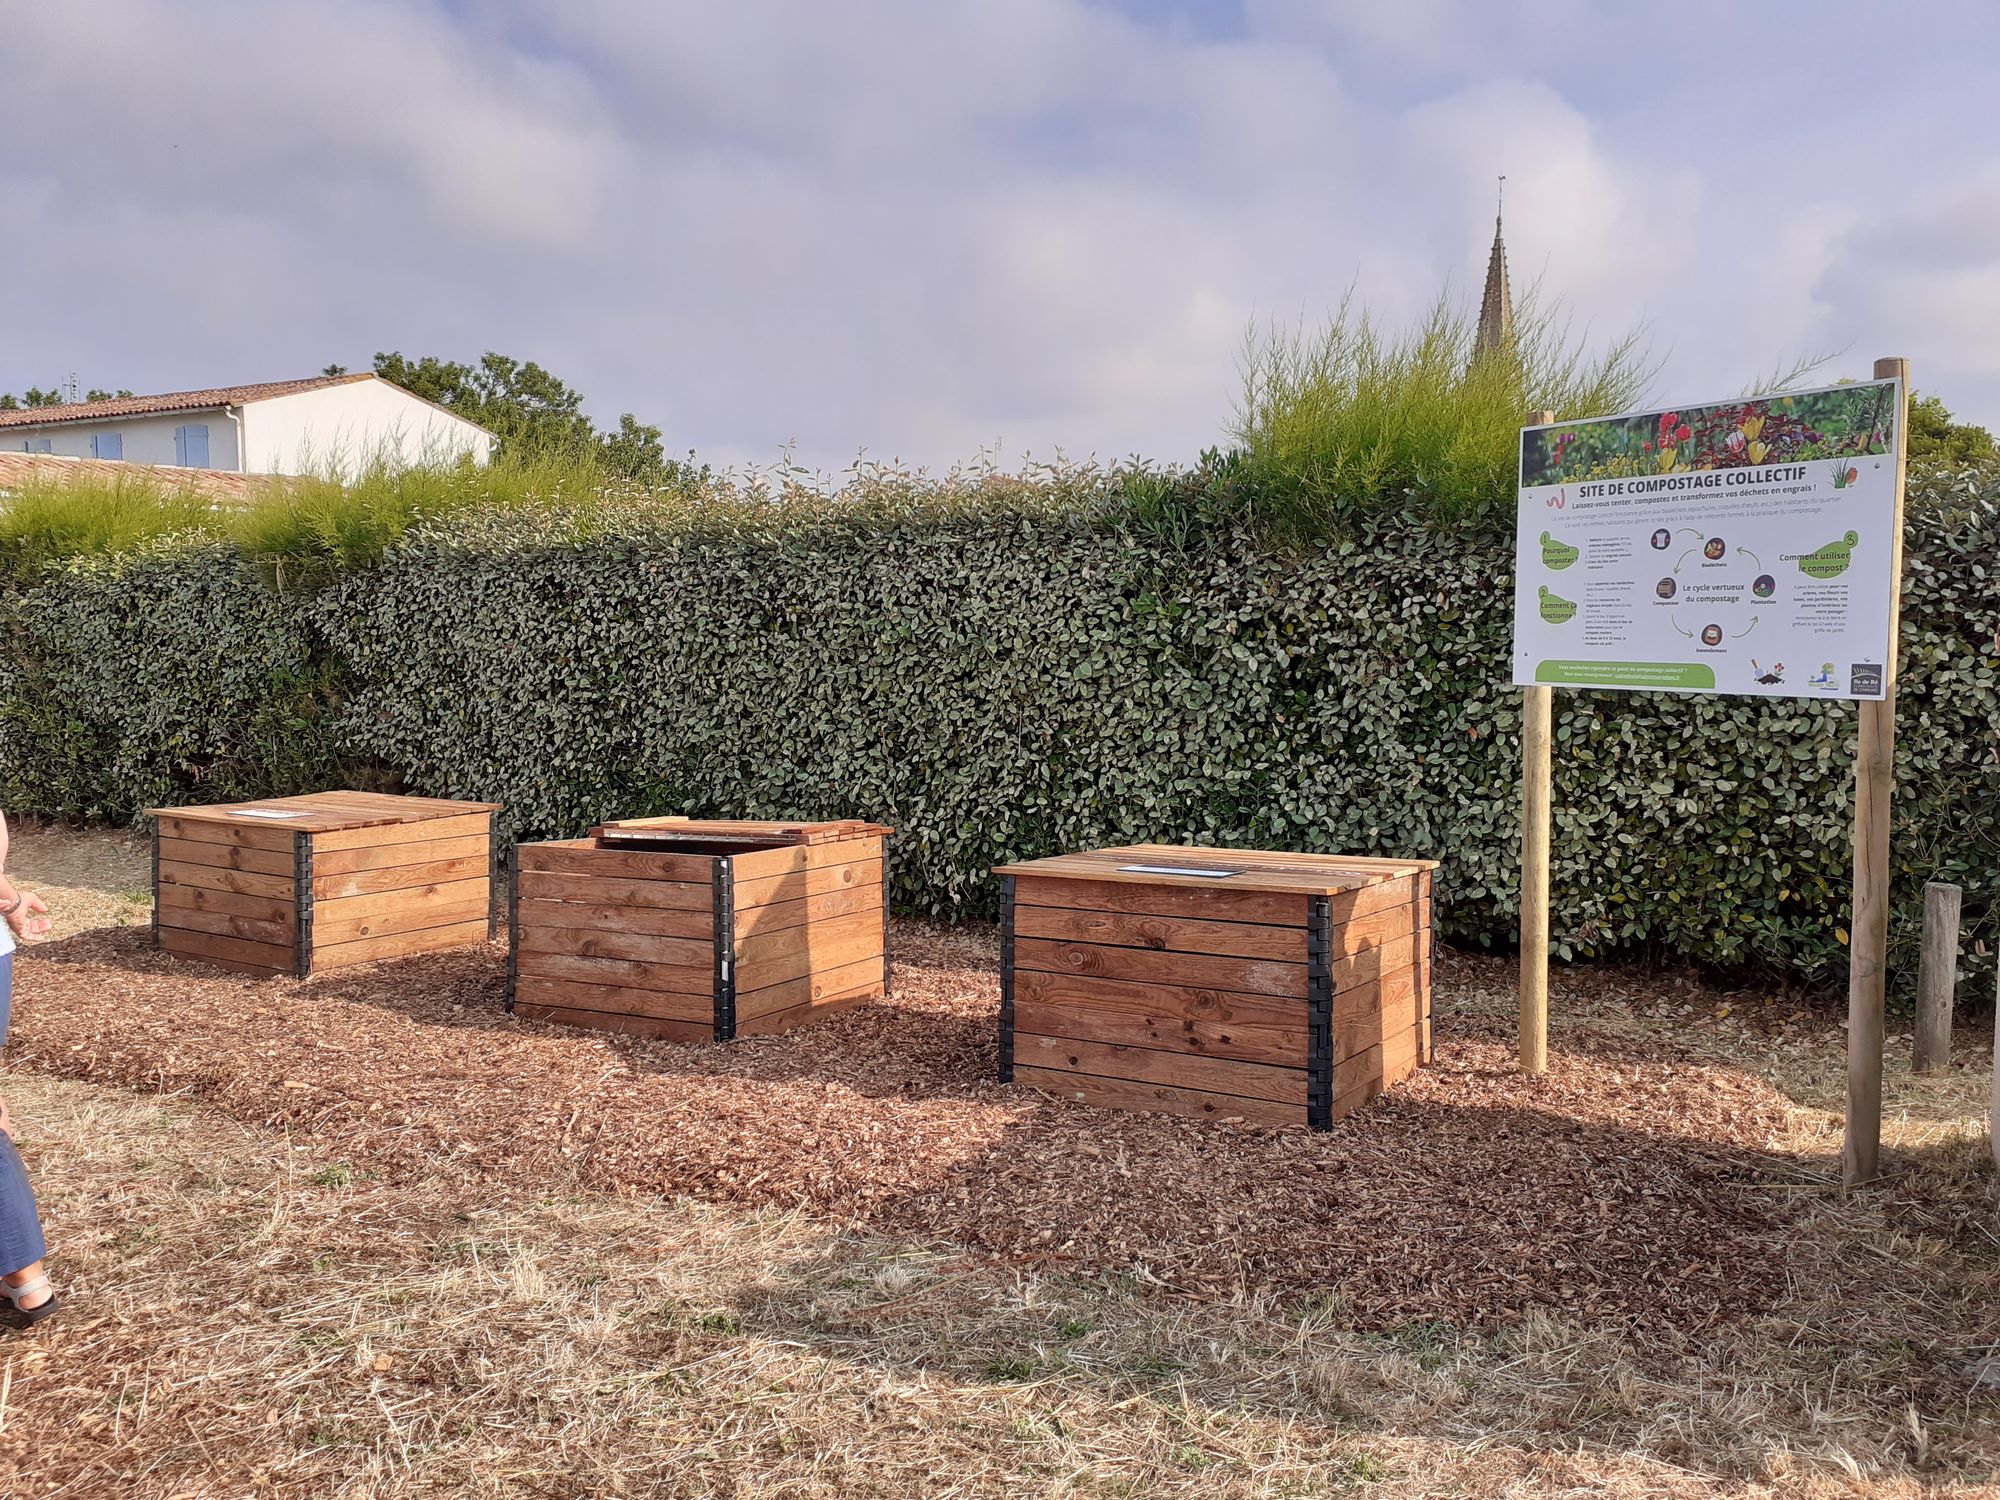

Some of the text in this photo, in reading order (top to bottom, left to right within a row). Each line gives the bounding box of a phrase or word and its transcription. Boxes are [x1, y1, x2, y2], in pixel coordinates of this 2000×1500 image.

[1579, 466, 1807, 498] SITE DE COMPOSTAGE COLLECTIF
[1571, 500, 1610, 509] Laissez-vous
[1611, 499, 1633, 507] tenter,
[1634, 496, 1670, 505] compostez
[1680, 492, 1724, 501] transformez
[1739, 489, 1769, 497] déchets
[1782, 484, 1812, 494] engrais
[1846, 534, 1855, 546] 3
[1542, 546, 1570, 556] Pourquoi
[1542, 557, 1575, 565] composter
[1779, 551, 1851, 562] Comment utiliser
[1807, 564, 1843, 574] compost
[1540, 588, 1547, 598] 2
[1682, 583, 1745, 593] Le cycle vertueux
[1695, 595, 1740, 604] compostage
[1570, 602, 1577, 611] ça
